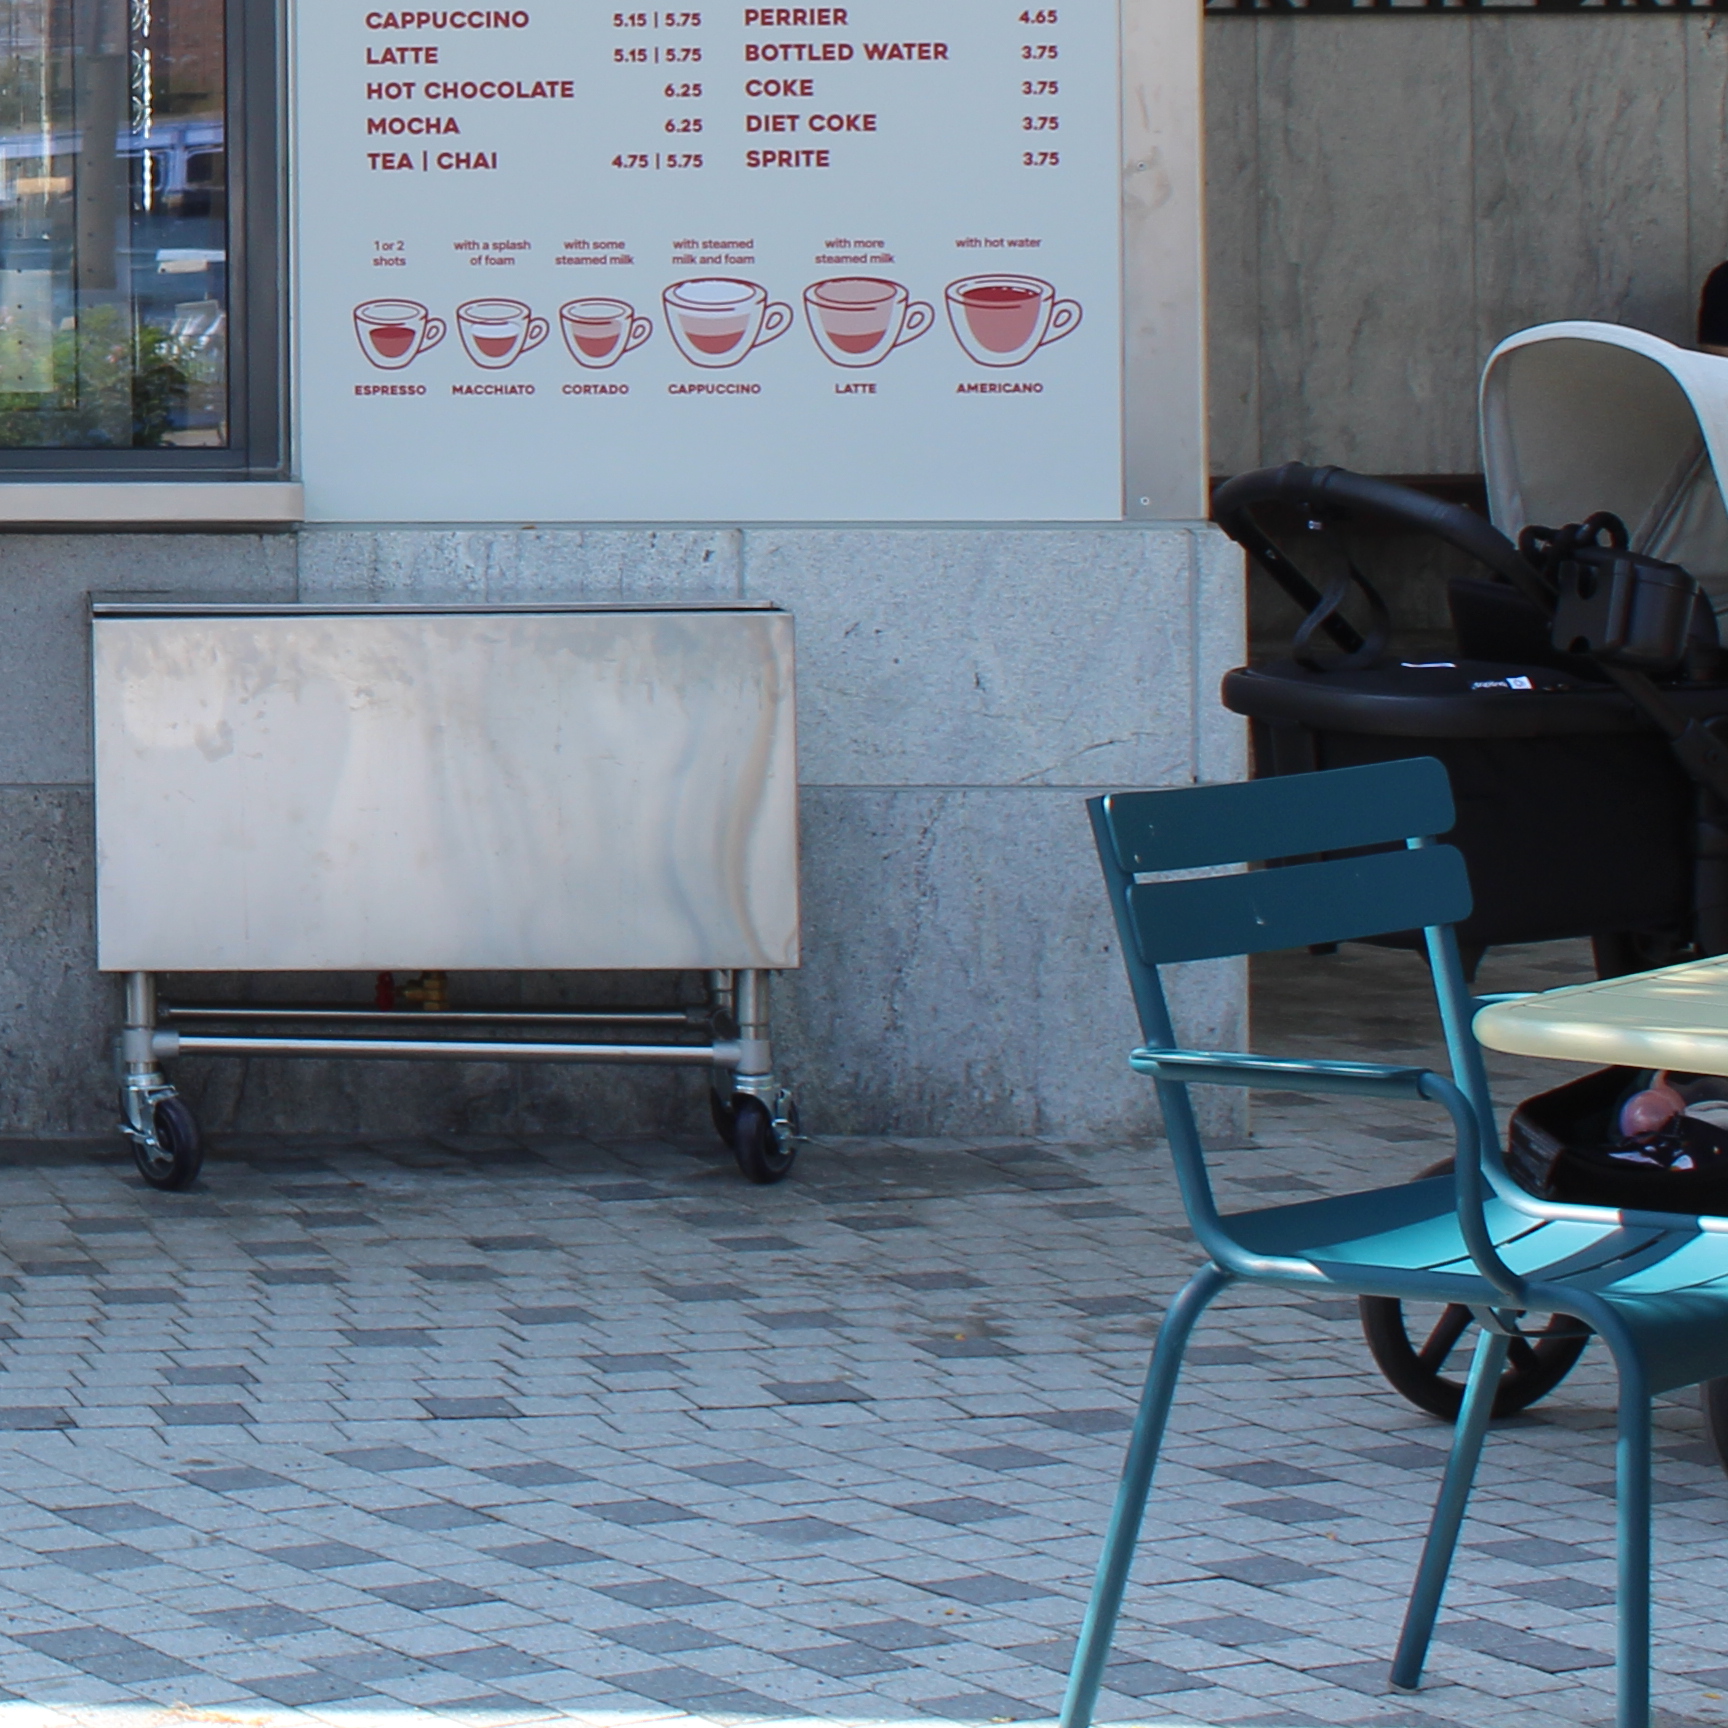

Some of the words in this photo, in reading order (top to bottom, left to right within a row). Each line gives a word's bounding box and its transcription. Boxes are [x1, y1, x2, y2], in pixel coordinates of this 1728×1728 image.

[365, 10, 530, 30] CAPPUCCINO
[613, 12, 647, 28] 5.15
[665, 12, 702, 27] 5.75
[744, 7, 848, 27] PERRIER
[1018, 9, 1058, 24] 4.65
[366, 46, 439, 65] LATTE
[613, 48, 648, 63] 5.15
[665, 47, 702, 63] 5.75
[745, 43, 854, 62] BOTTLED
[863, 42, 949, 61] WATER
[1022, 45, 1059, 60] 3.75
[366, 81, 417, 100] HOT
[424, 80, 575, 100] CHOCOLATE
[664, 83, 703, 98] 6.25
[745, 78, 814, 97] COKE
[1022, 80, 1059, 95] 3.75
[367, 116, 461, 135] MOCHA
[664, 118, 703, 133] 6.25
[746, 114, 800, 133] DIET
[808, 113, 877, 132] COKE
[1022, 116, 1060, 131] 3.75
[366, 152, 414, 171] TEA
[436, 151, 497, 170] CHAI
[611, 154, 649, 169] 4.75
[666, 153, 704, 169] 5.75
[746, 149, 830, 168] SPRITE
[1023, 151, 1060, 166] 3.75
[563, 239, 591, 250] with
[592, 241, 626, 250] some
[824, 238, 852, 249] with
[853, 239, 886, 249] more
[955, 237, 982, 248] with
[984, 237, 1005, 248] hot
[1006, 237, 1042, 248] water
[554, 254, 608, 266] steamed
[609, 254, 635, 265] milk
[814, 253, 868, 264] steamed
[869, 253, 895, 264] milk
[354, 384, 427, 396] ESPRESSO
[452, 384, 536, 396] MACCHIATO
[561, 383, 630, 395] CORTADO
[667, 383, 762, 395] CAPPUCCINO
[835, 383, 877, 394] LATTE
[956, 382, 1044, 394] AMERICANO
